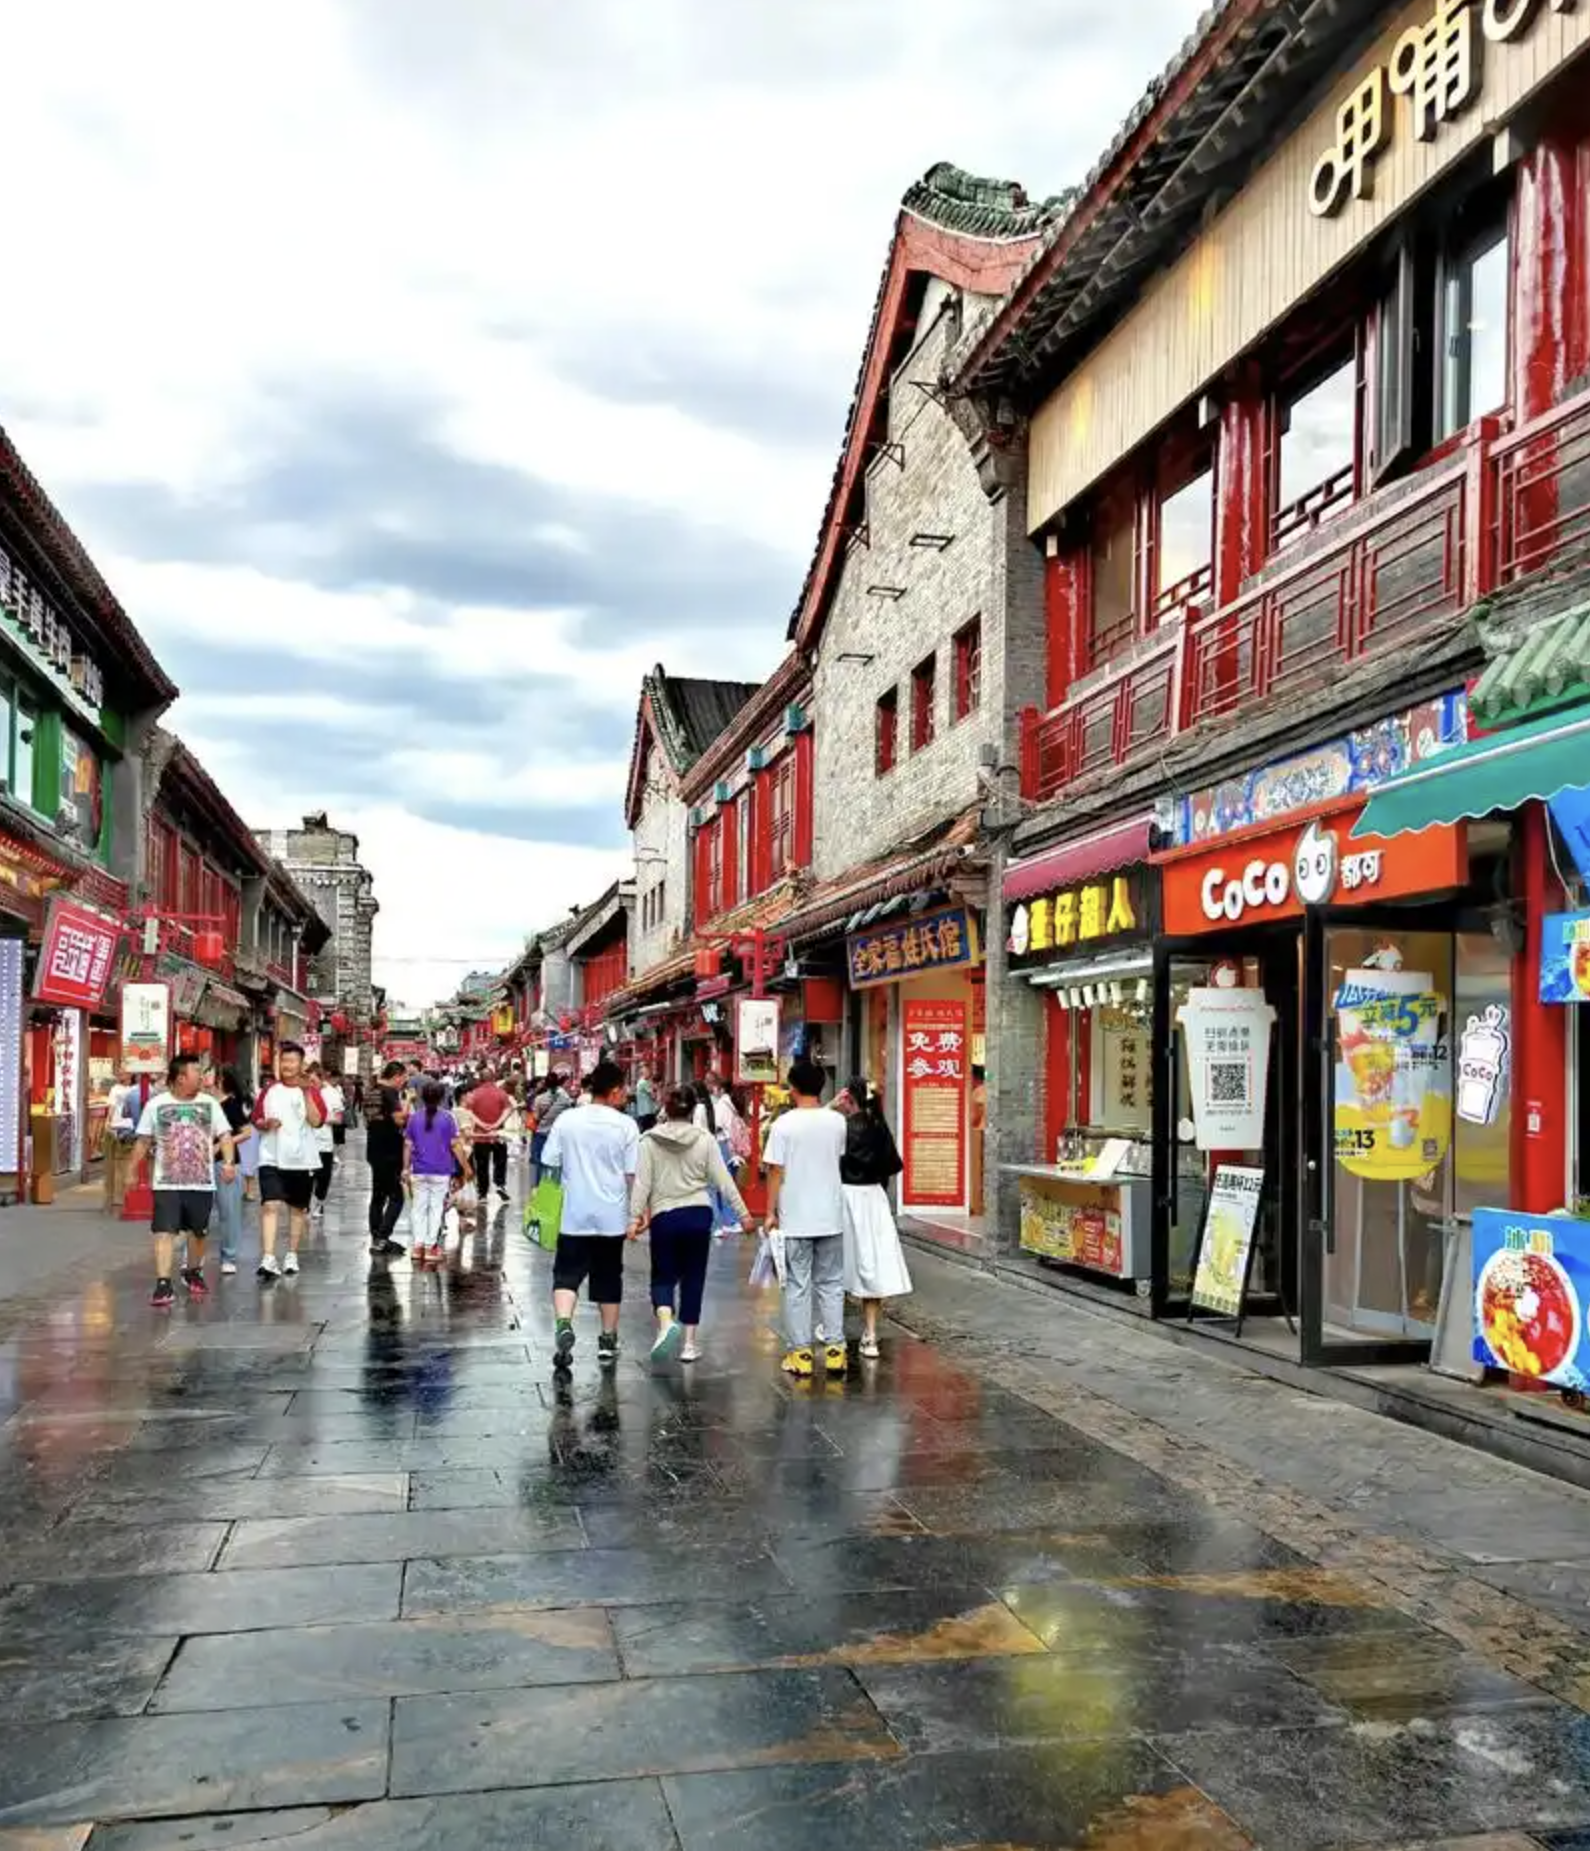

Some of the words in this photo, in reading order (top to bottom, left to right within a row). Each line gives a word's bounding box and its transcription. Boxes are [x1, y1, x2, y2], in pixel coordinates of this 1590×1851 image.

[1308, 0, 1573, 217] 呷哺
[1201, 860, 1290, 920] CoCo
[906, 1031, 963, 1053] 免费
[906, 1056, 964, 1079] 参观
[1463, 1063, 1494, 1081] CoCo
[1355, 1129, 1375, 1149] 13
